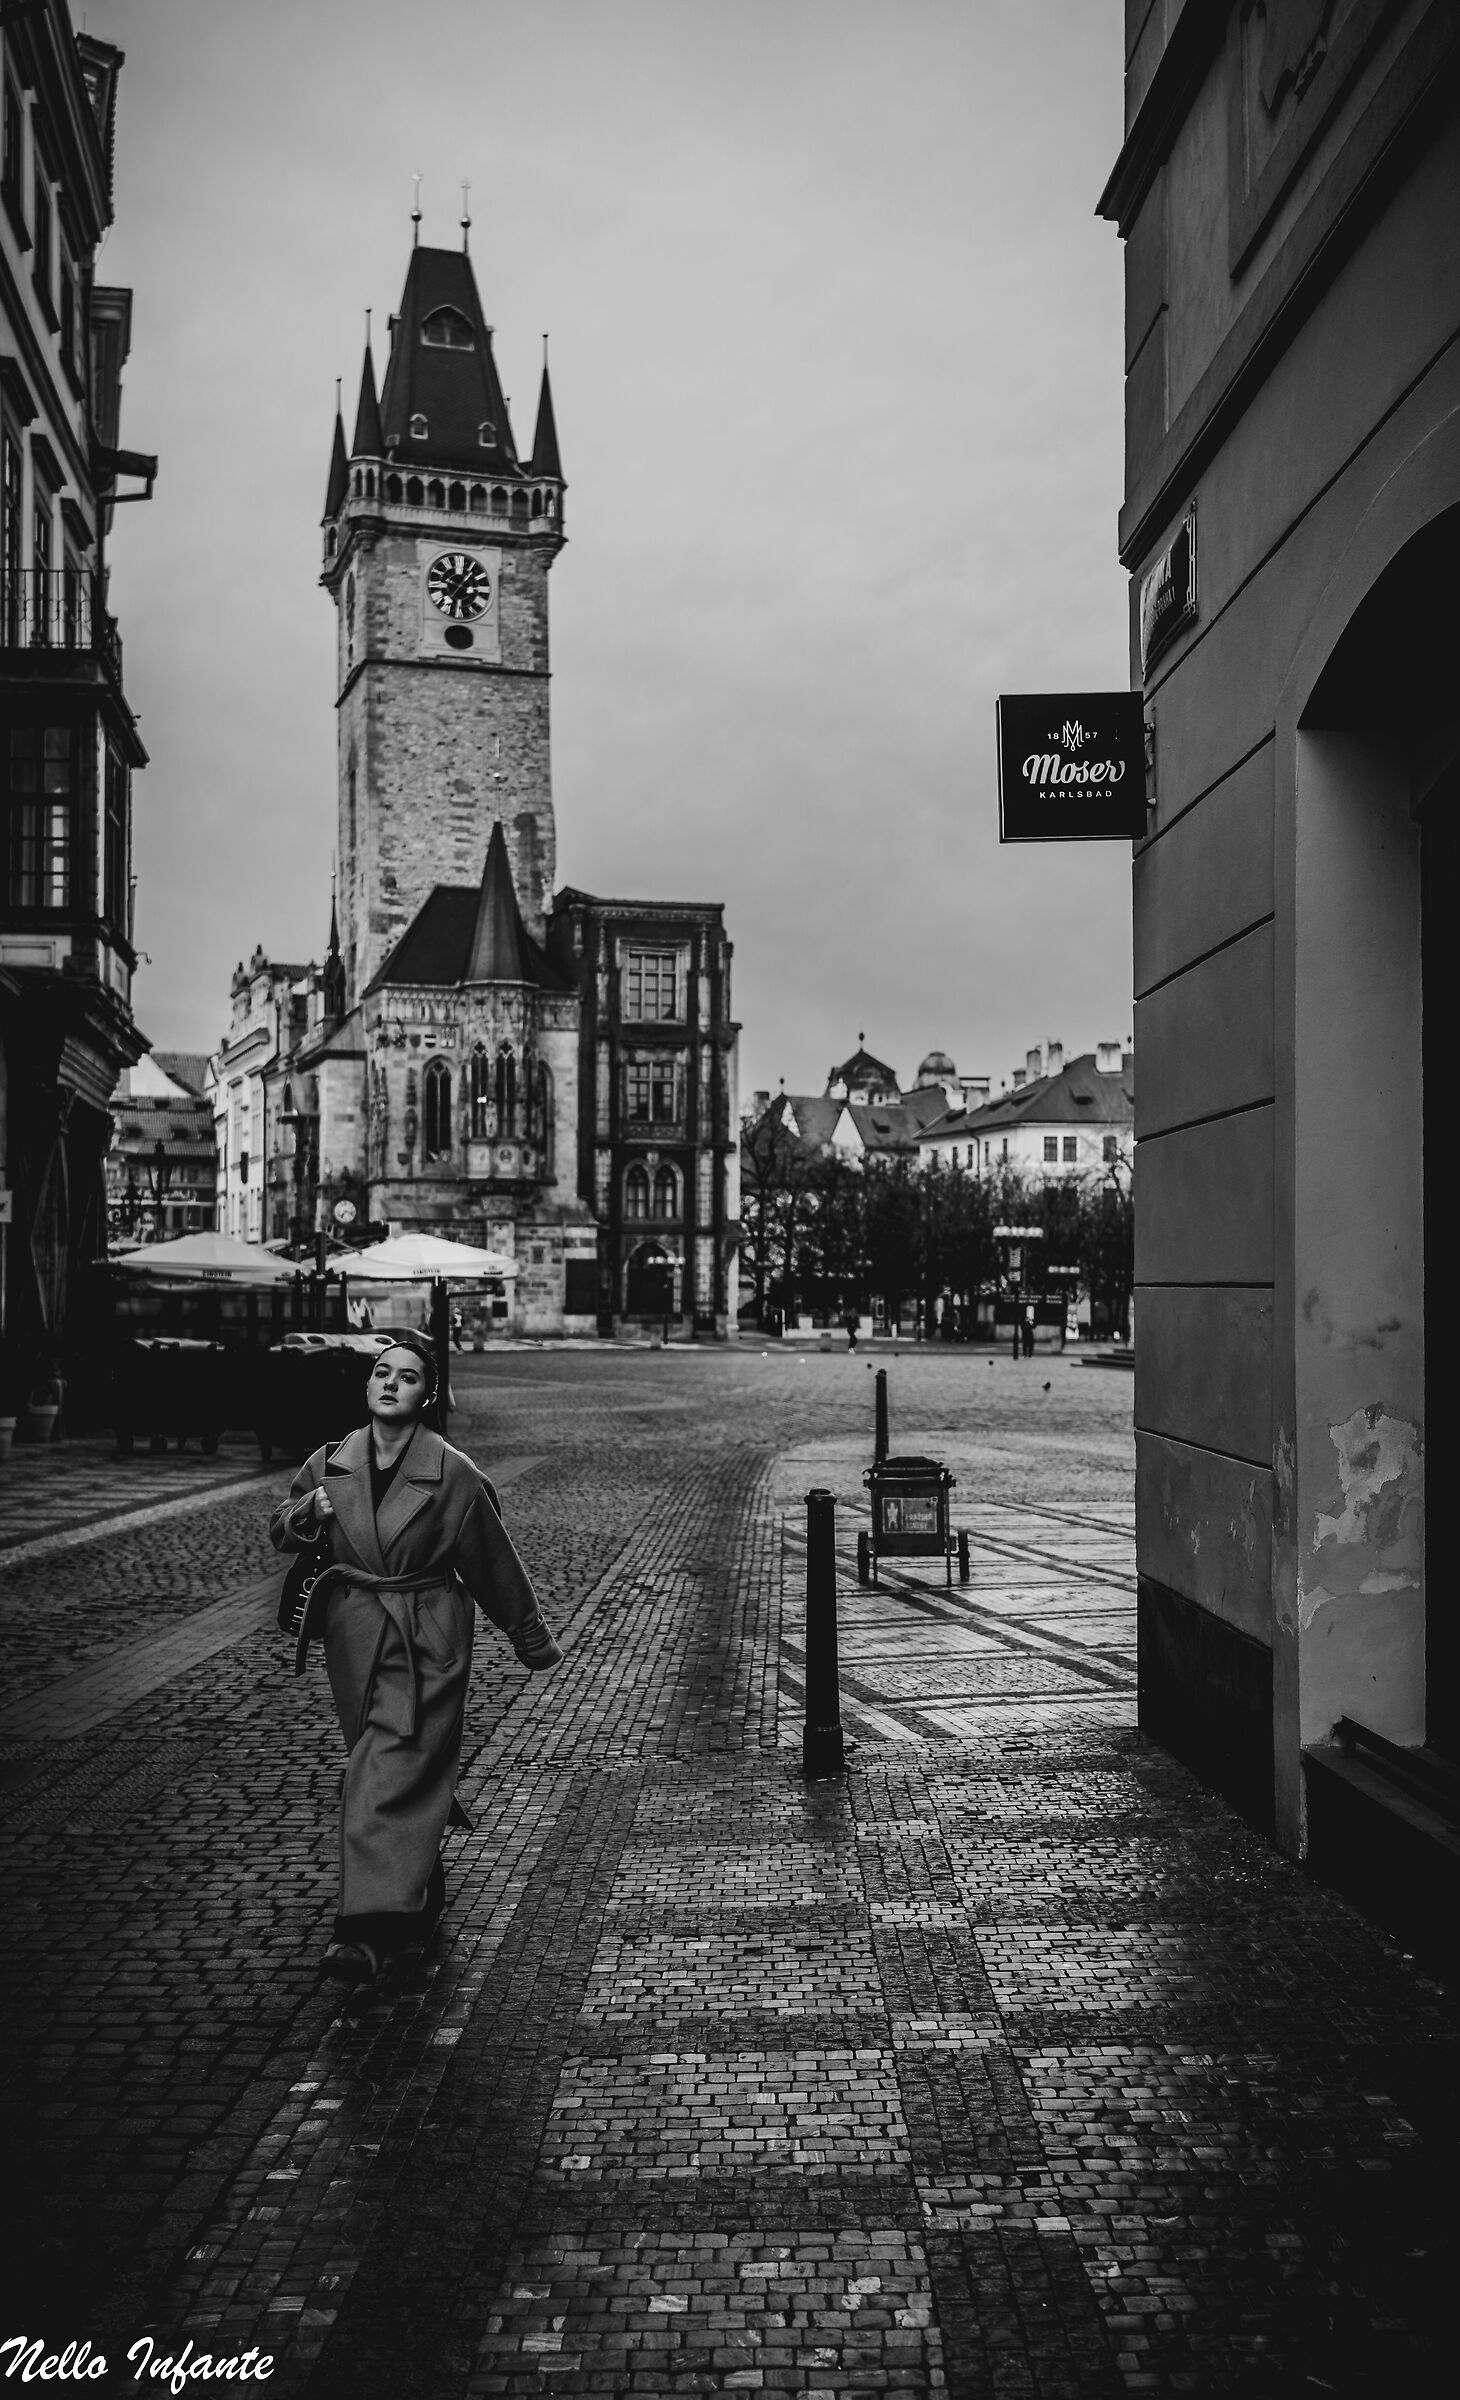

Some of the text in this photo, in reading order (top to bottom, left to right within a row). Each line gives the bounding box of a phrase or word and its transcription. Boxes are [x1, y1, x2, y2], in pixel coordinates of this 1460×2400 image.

[1047, 732, 1060, 740] 18
[1084, 731, 1098, 739] 57
[1022, 753, 1126, 785] Moser
[1039, 790, 1112, 799] KARLSBAD
